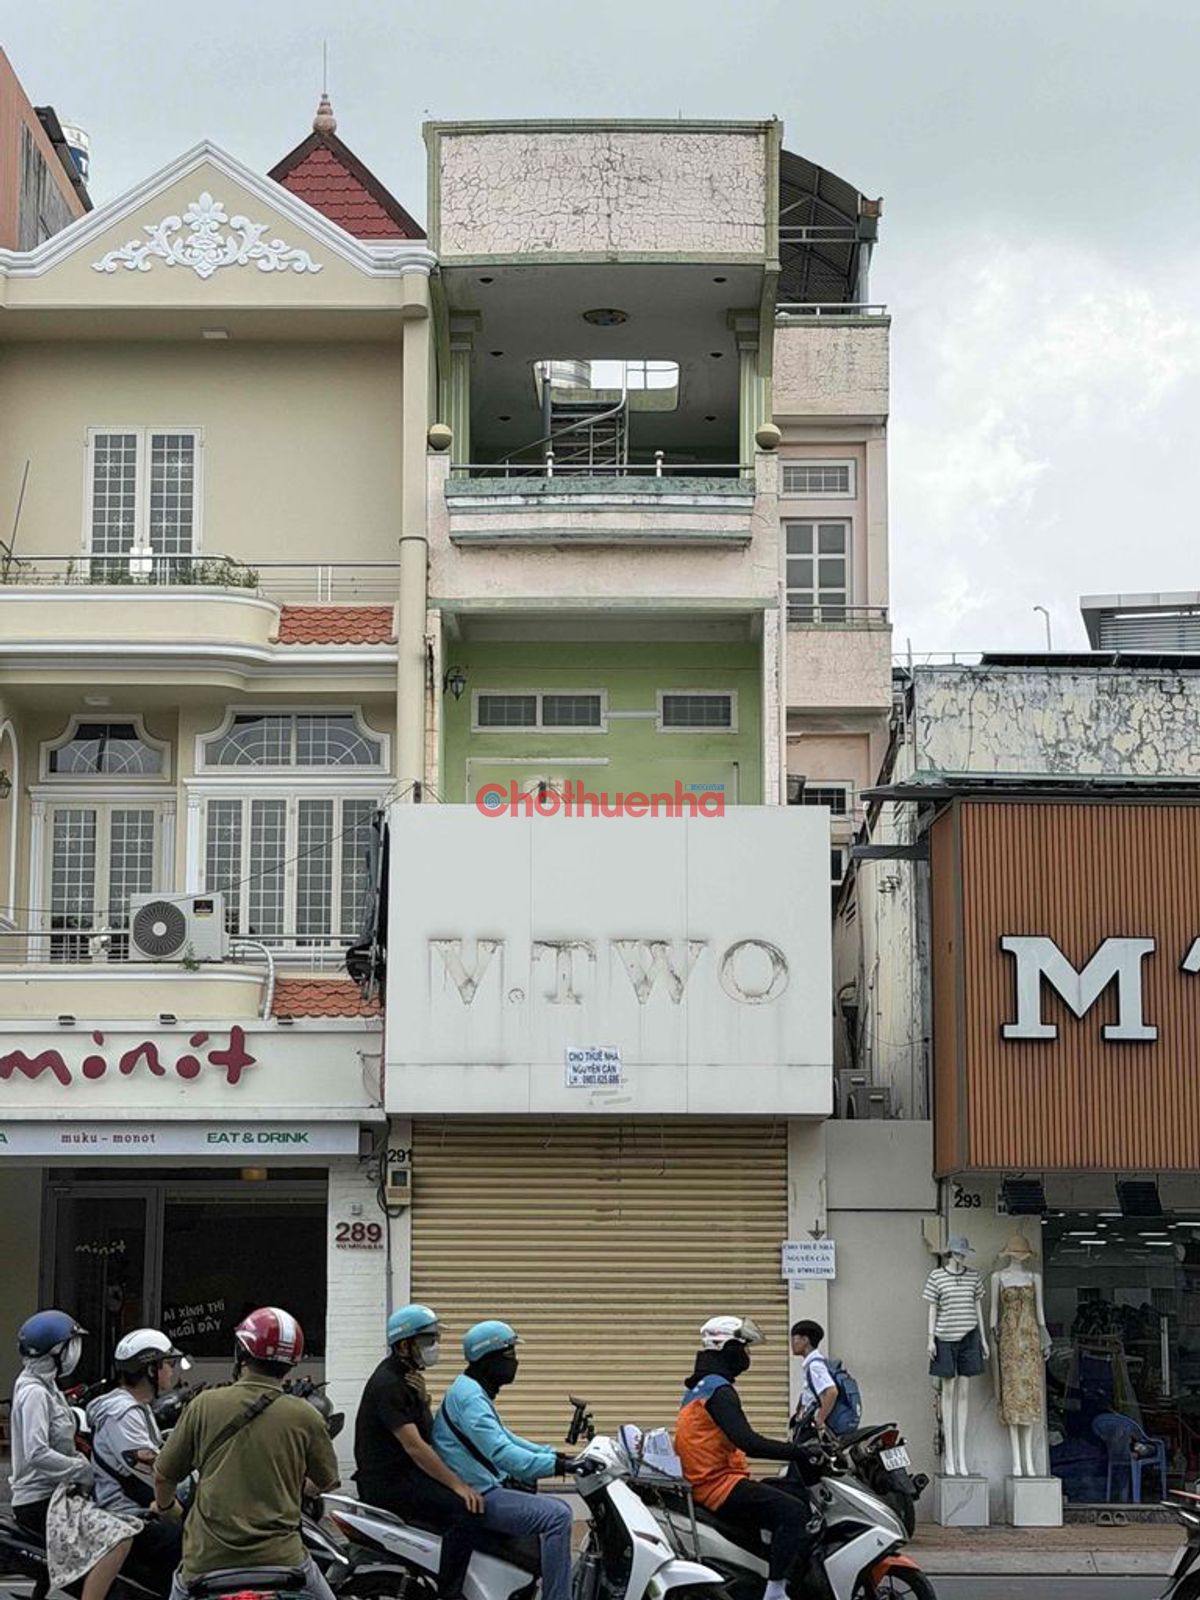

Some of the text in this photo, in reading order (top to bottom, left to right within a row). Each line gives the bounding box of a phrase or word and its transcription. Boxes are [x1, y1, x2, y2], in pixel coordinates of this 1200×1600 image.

[61, 1132, 98, 1143] muku
[112, 1133, 156, 1143] monot
[207, 1132, 309, 1143] EAT & DRINK
[388, 1148, 412, 1162] 291
[954, 1193, 981, 1208] 293
[335, 1221, 382, 1242] 289
